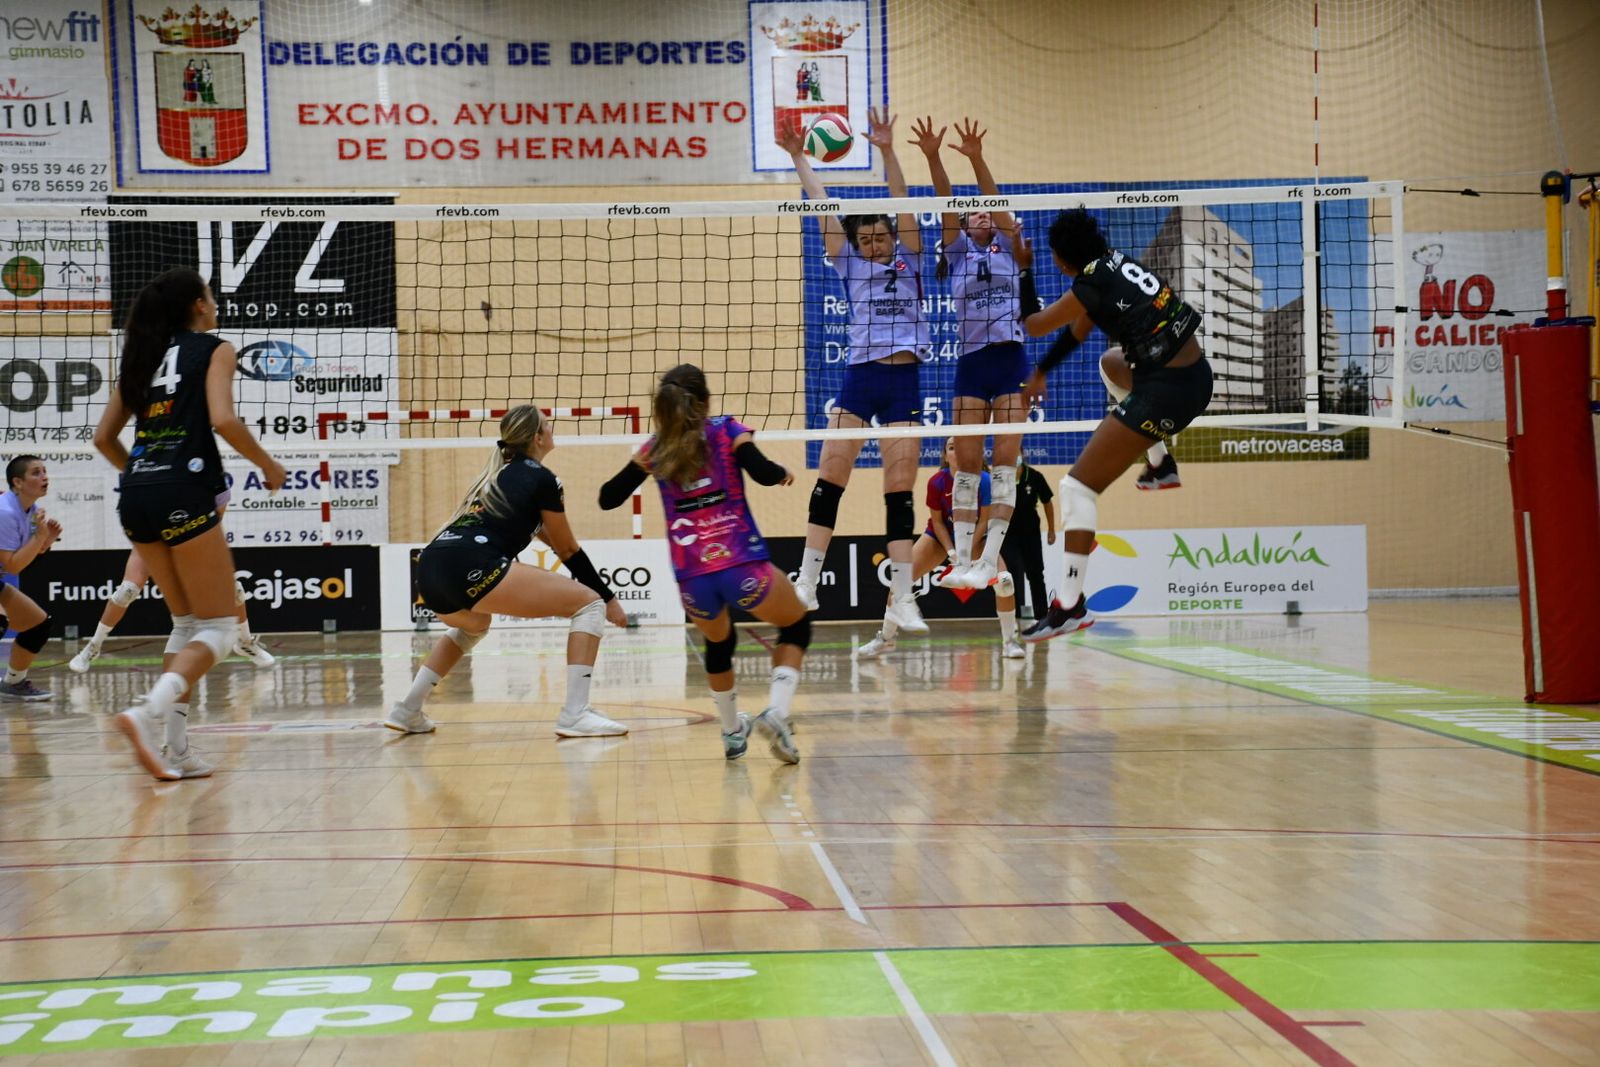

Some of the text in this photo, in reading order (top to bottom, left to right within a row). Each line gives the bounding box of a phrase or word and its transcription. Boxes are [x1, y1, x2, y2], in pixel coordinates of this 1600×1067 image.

[8, 44, 85, 60] gimnasio
[268, 36, 746, 66] DELEGACIÓN DE DEPORTES
[298, 101, 747, 126] EXCMO. AYUNTAMIENTO
[338, 136, 708, 161] DE DOS HERMANAS
[11, 163, 107, 174] 955 39 46 27
[12, 180, 108, 192] 678 5659 26
[947, 198, 1009, 209] rfevb.com
[1116, 192, 1179, 204] rfevb.com
[80, 206, 148, 217] rfevb.com
[260, 207, 326, 218] rfevb.com
[436, 207, 500, 217] rfevb.com
[608, 205, 670, 216] rfevb.com
[778, 202, 840, 213] rfevb.com
[8, 240, 104, 252] JUAN VARELA
[977, 261, 992, 284] 4
[1121, 262, 1160, 295] 8
[884, 270, 898, 293] 2
[1419, 274, 1495, 321] NO
[151, 345, 183, 395] 4
[295, 374, 383, 396] Seguridad
[41, 428, 69, 441] 725
[1221, 437, 1345, 455] metrovacesa
[244, 469, 380, 491] AESORES
[242, 497, 305, 509] Contable
[263, 531, 292, 542] 652
[335, 530, 364, 541] 919
[1168, 531, 1330, 569] Andalucía
[1167, 580, 1315, 596] Región Europea del
[1168, 599, 1244, 611] DEPORTE
